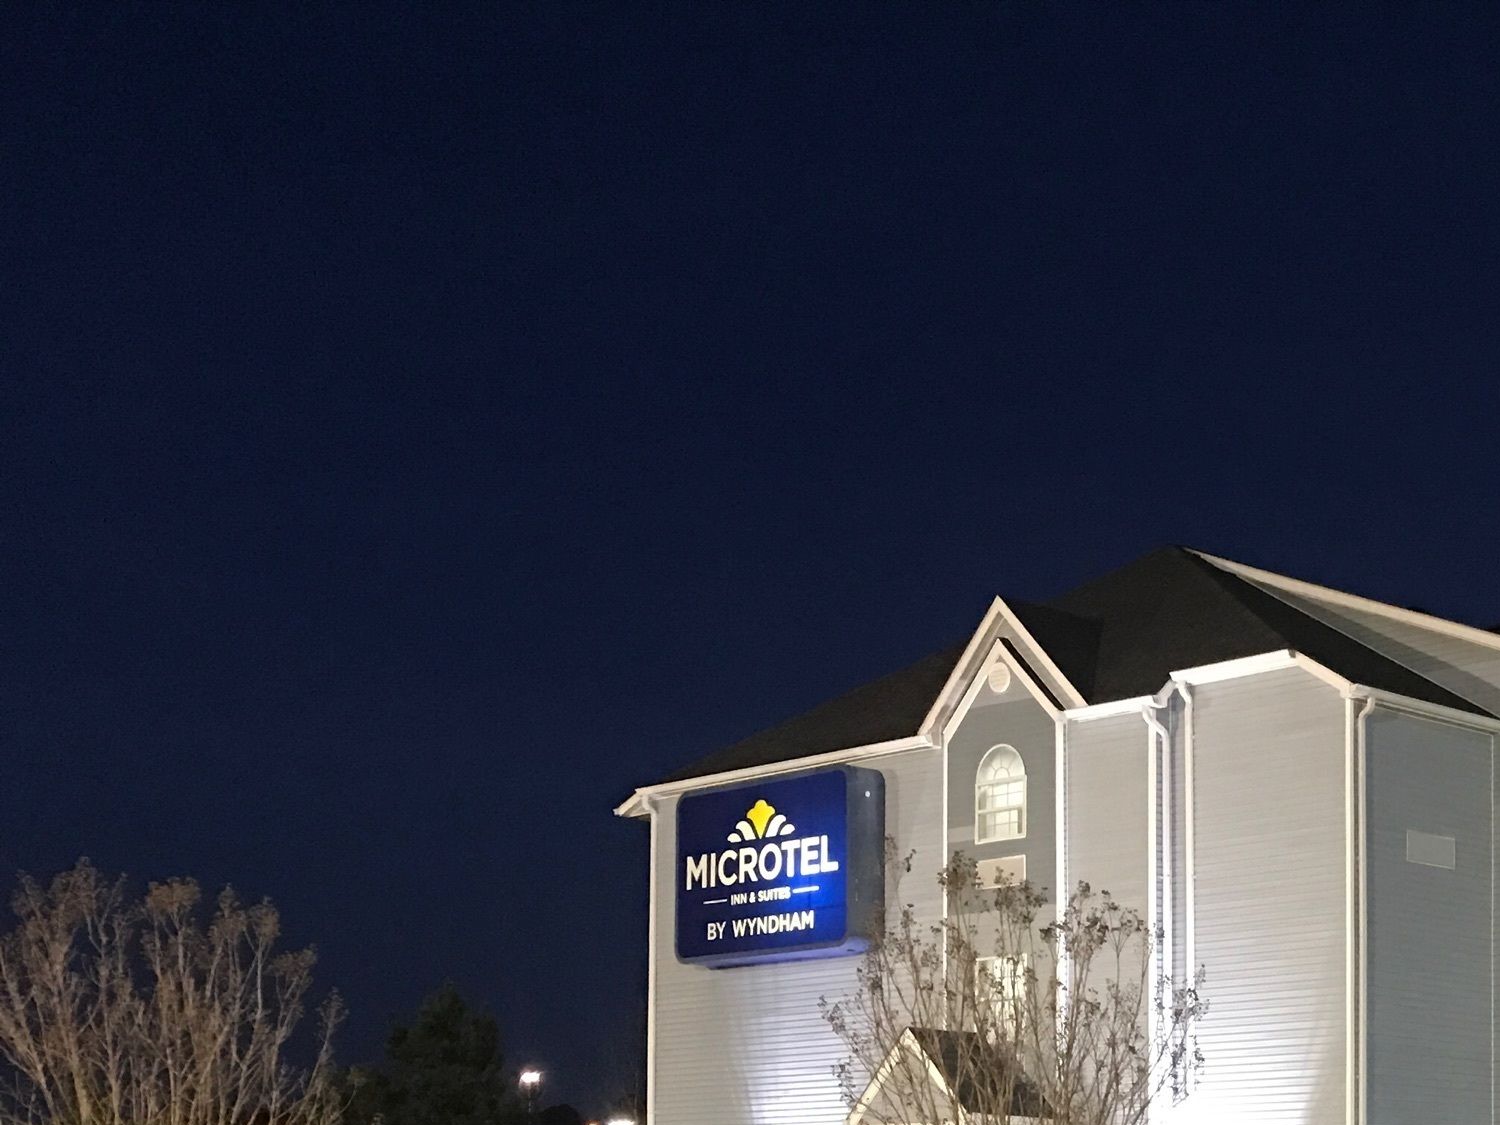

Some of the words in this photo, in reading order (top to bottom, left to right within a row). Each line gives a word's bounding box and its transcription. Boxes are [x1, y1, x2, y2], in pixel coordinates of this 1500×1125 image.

[686, 835, 839, 890] MICROTEL
[730, 892, 747, 905] INN
[749, 892, 756, 904] &
[758, 887, 791, 902] SUITES
[707, 921, 726, 941] BY
[732, 910, 815, 938] WYNDHAM
